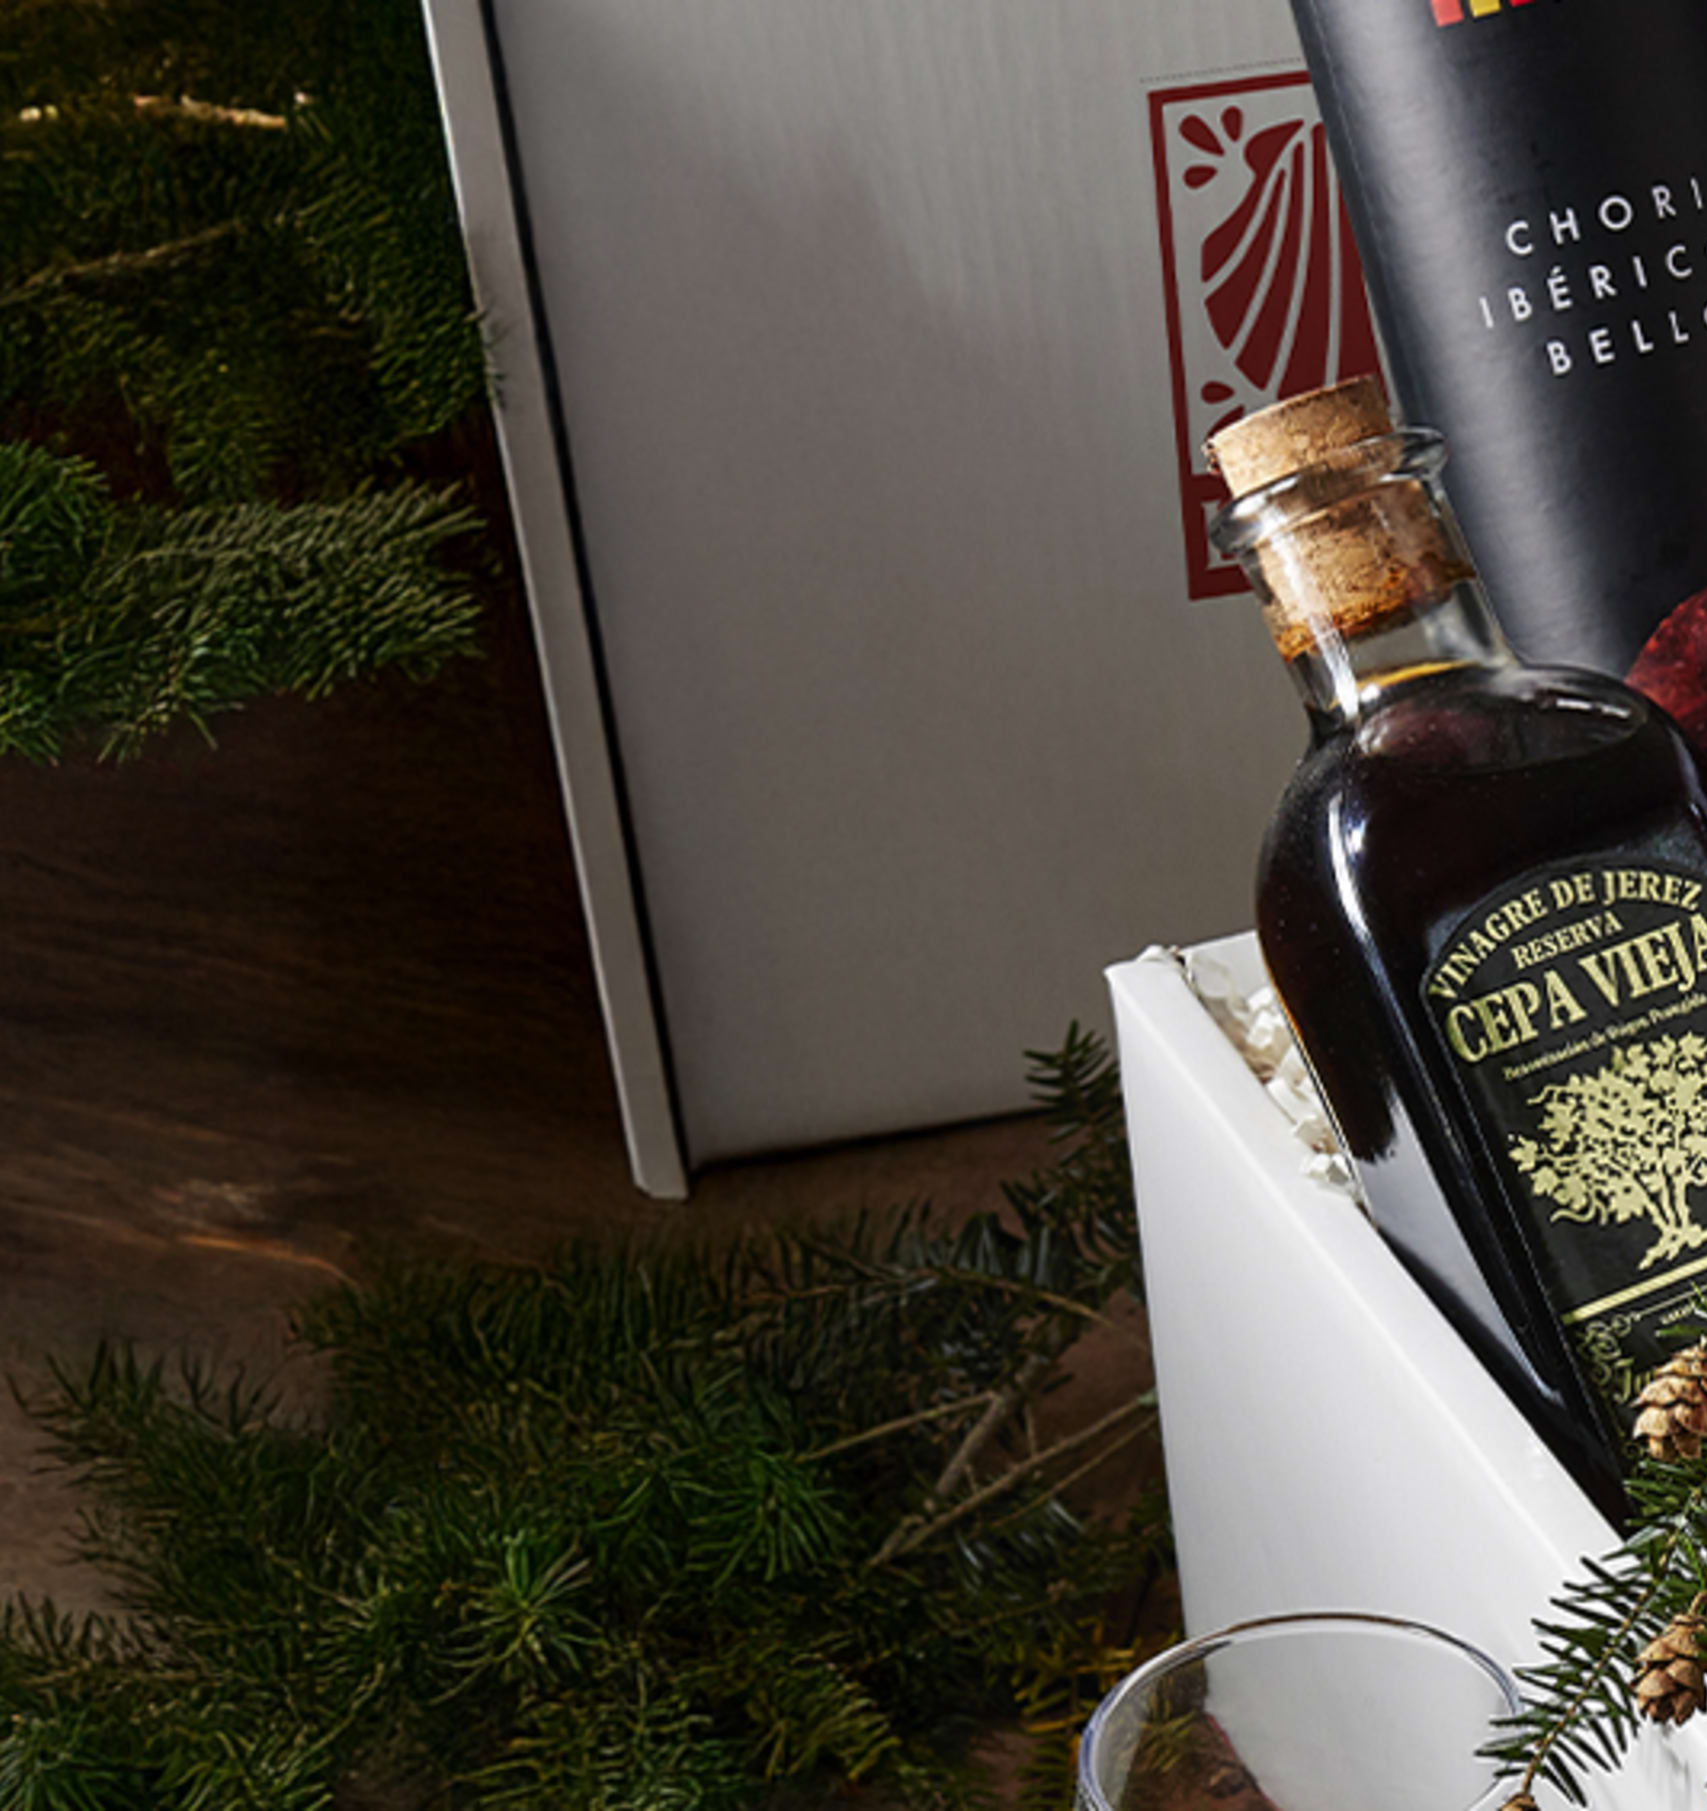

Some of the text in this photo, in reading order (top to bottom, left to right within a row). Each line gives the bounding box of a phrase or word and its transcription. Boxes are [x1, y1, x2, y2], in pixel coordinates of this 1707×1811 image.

[1429, 870, 1704, 999] VINAGRE DE JEREZ
[1510, 909, 1625, 970] RESERVA
[1446, 969, 1588, 1064] CEPA
